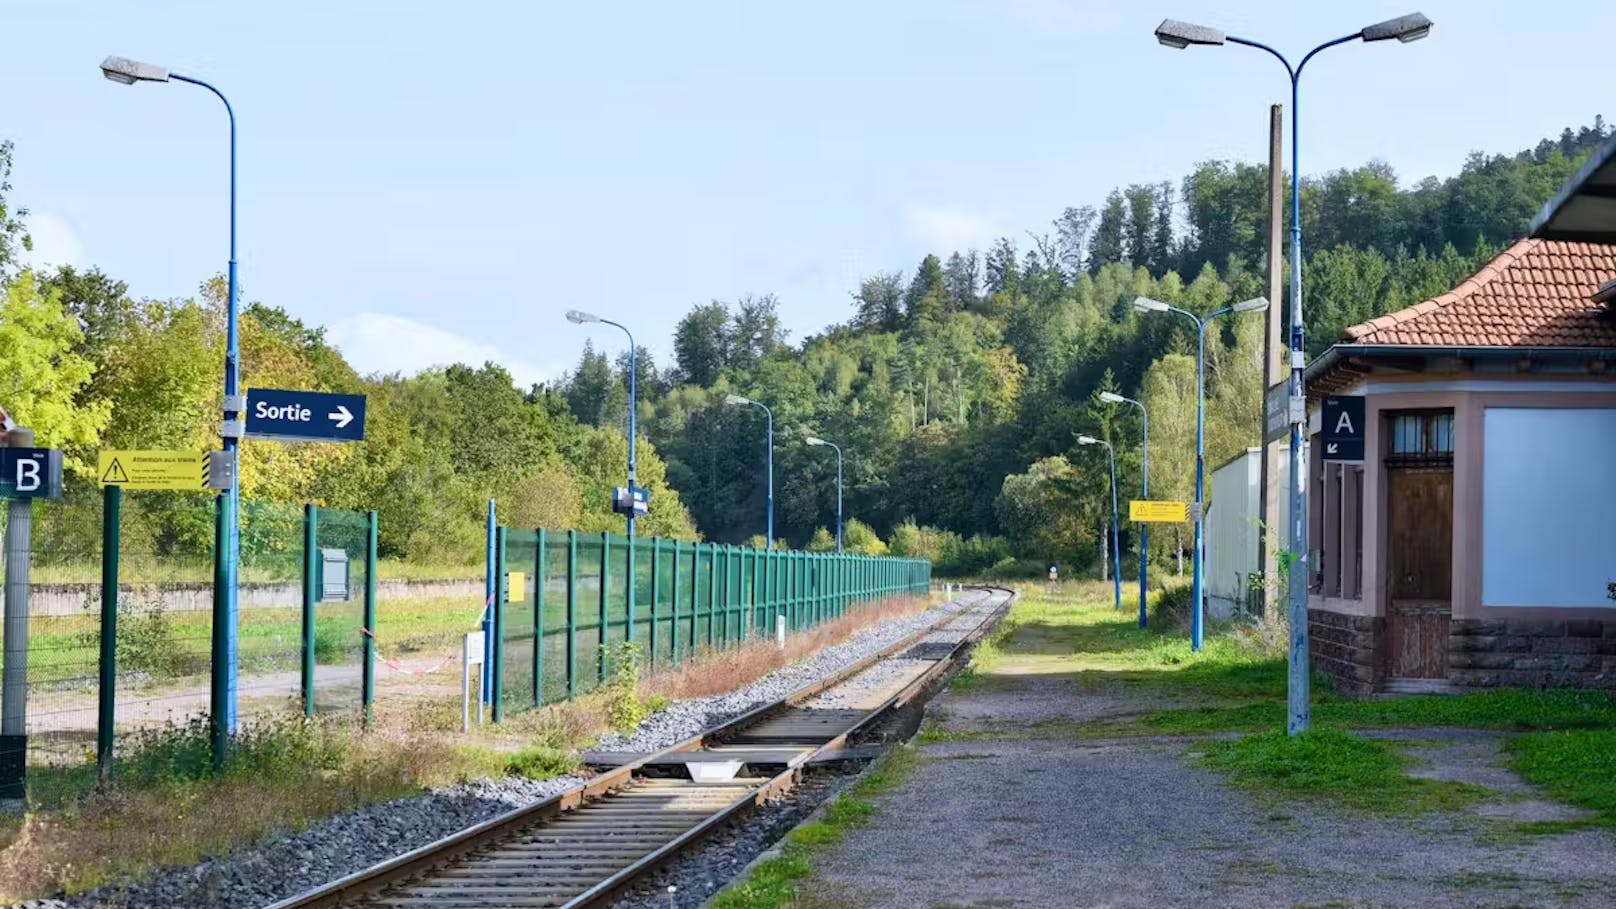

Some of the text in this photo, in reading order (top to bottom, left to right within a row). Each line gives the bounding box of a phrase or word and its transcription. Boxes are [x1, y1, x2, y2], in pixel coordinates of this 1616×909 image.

[255, 401, 311, 421] Sortie
[1335, 410, 1354, 434] A
[16, 458, 41, 491] B
